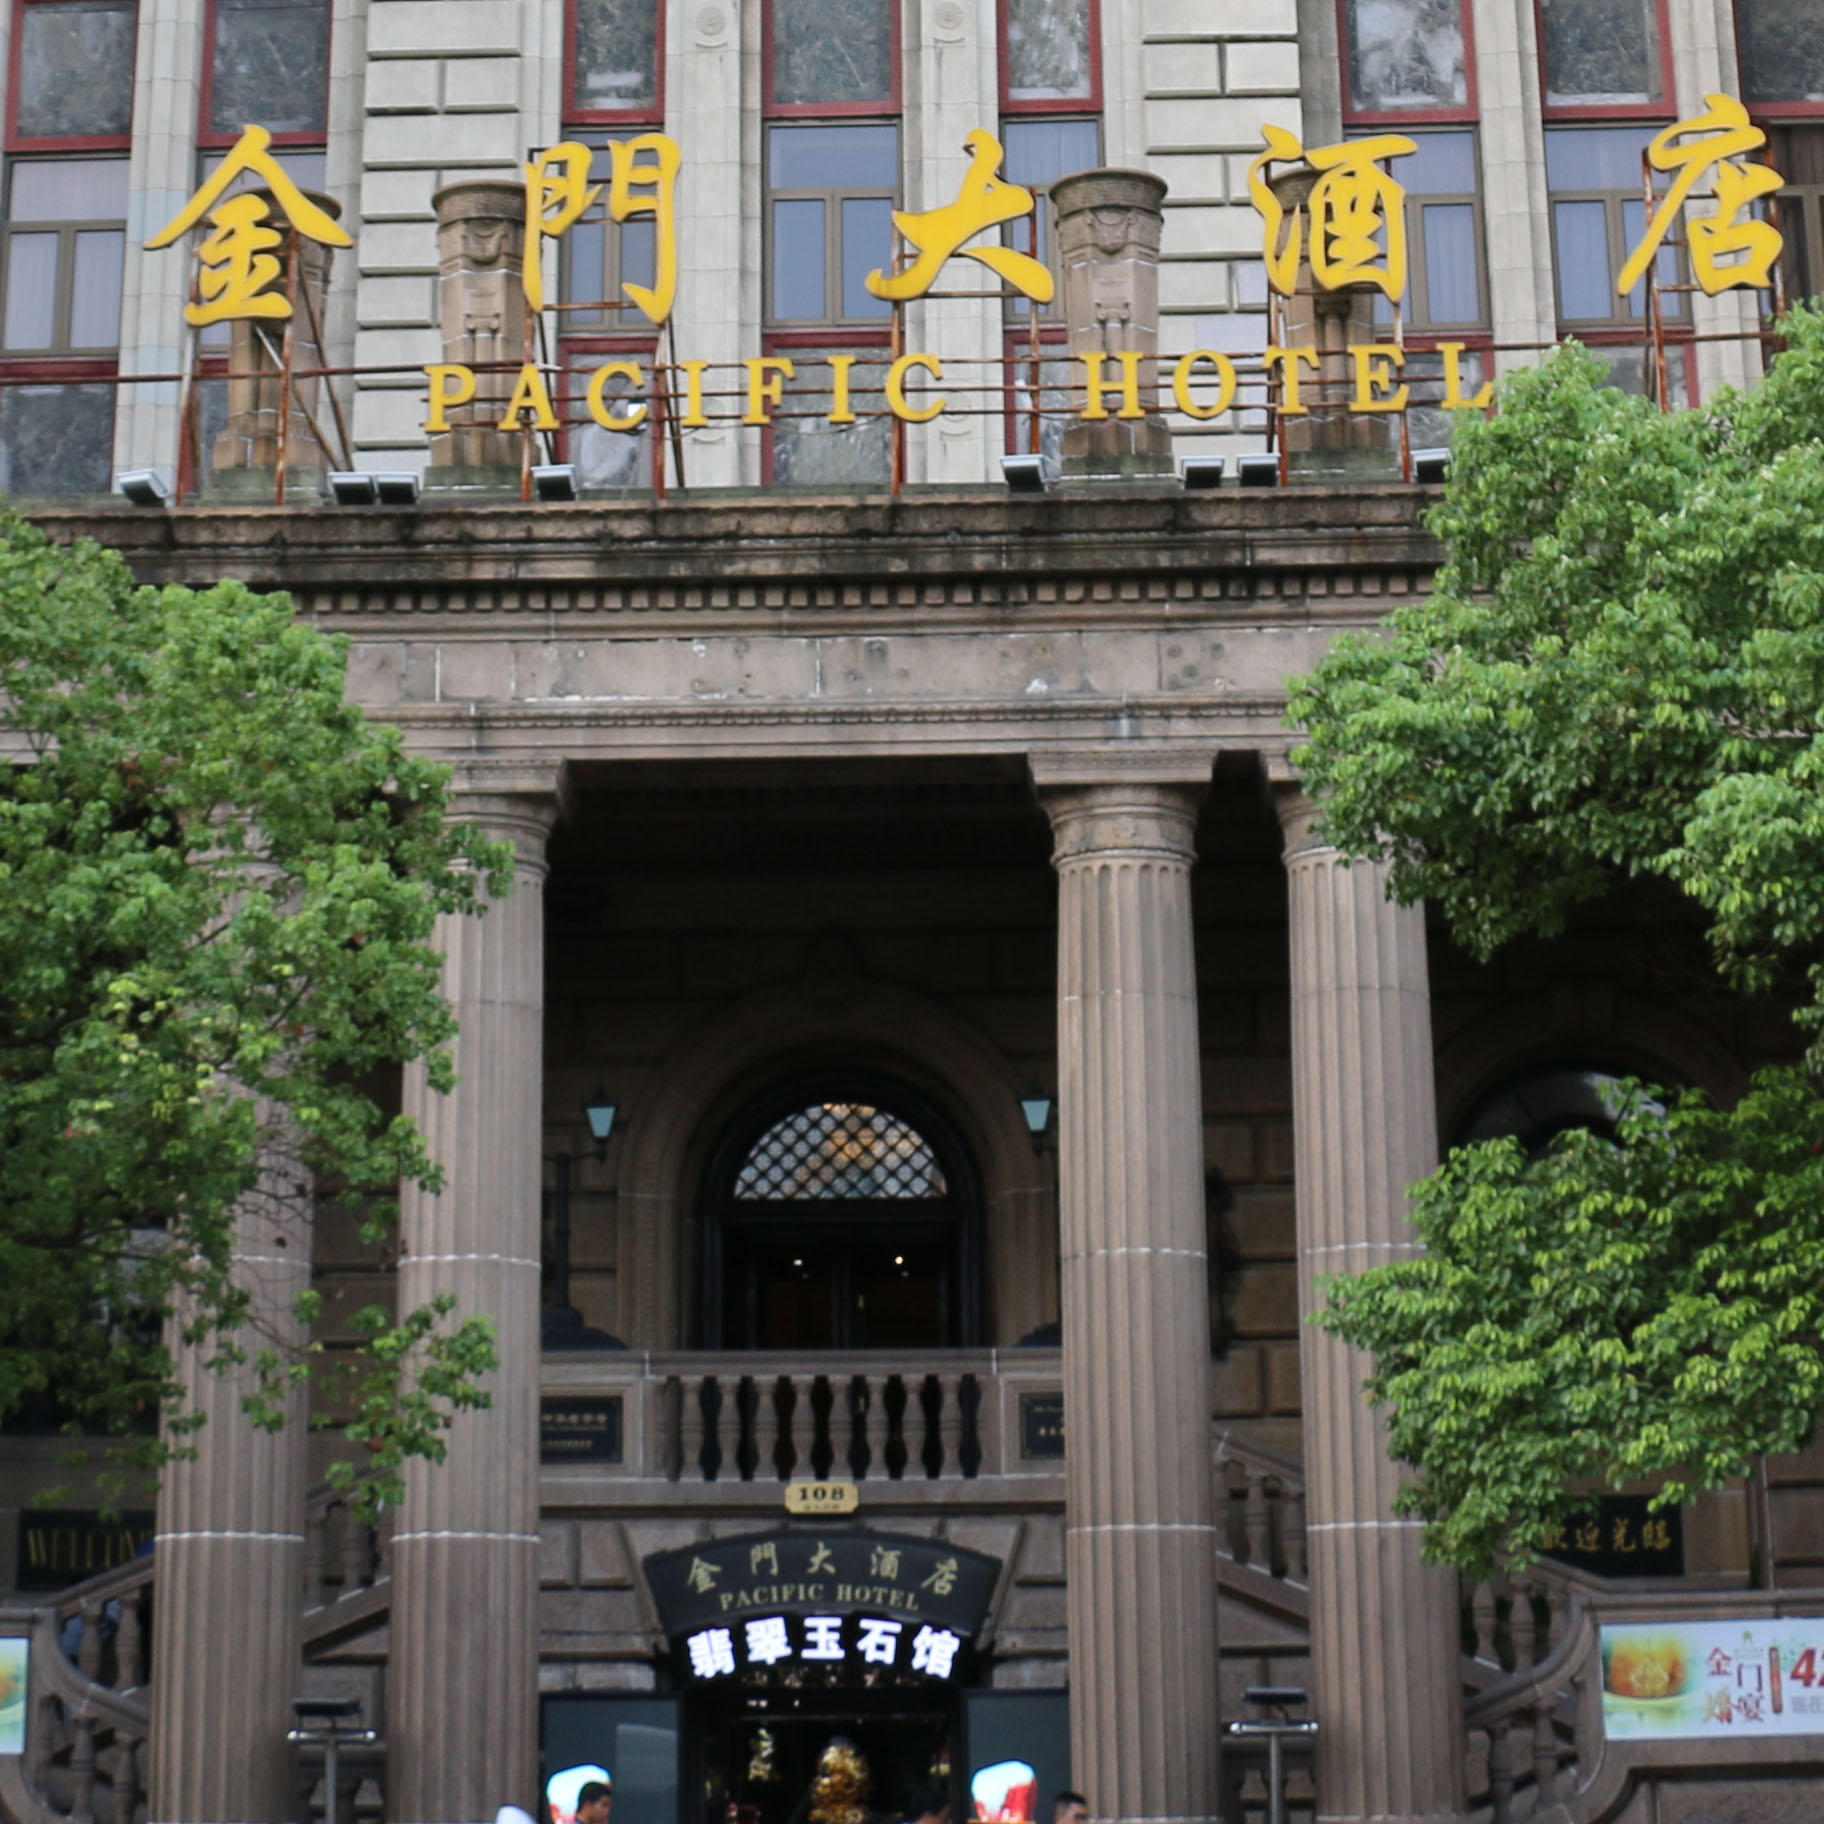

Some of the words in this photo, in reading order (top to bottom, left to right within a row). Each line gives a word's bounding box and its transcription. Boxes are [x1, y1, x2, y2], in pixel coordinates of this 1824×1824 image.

[144, 93, 1784, 324] 金門大酒店
[423, 353, 947, 433] PACIFIC
[1078, 341, 1496, 421] HOTEL
[799, 1487, 845, 1501] 108
[685, 1540, 959, 1596] 金門大酒店
[719, 1583, 825, 1611] PACIFIC
[836, 1584, 920, 1611] HOTEL
[686, 1615, 960, 1680] 翡翠玉石馆
